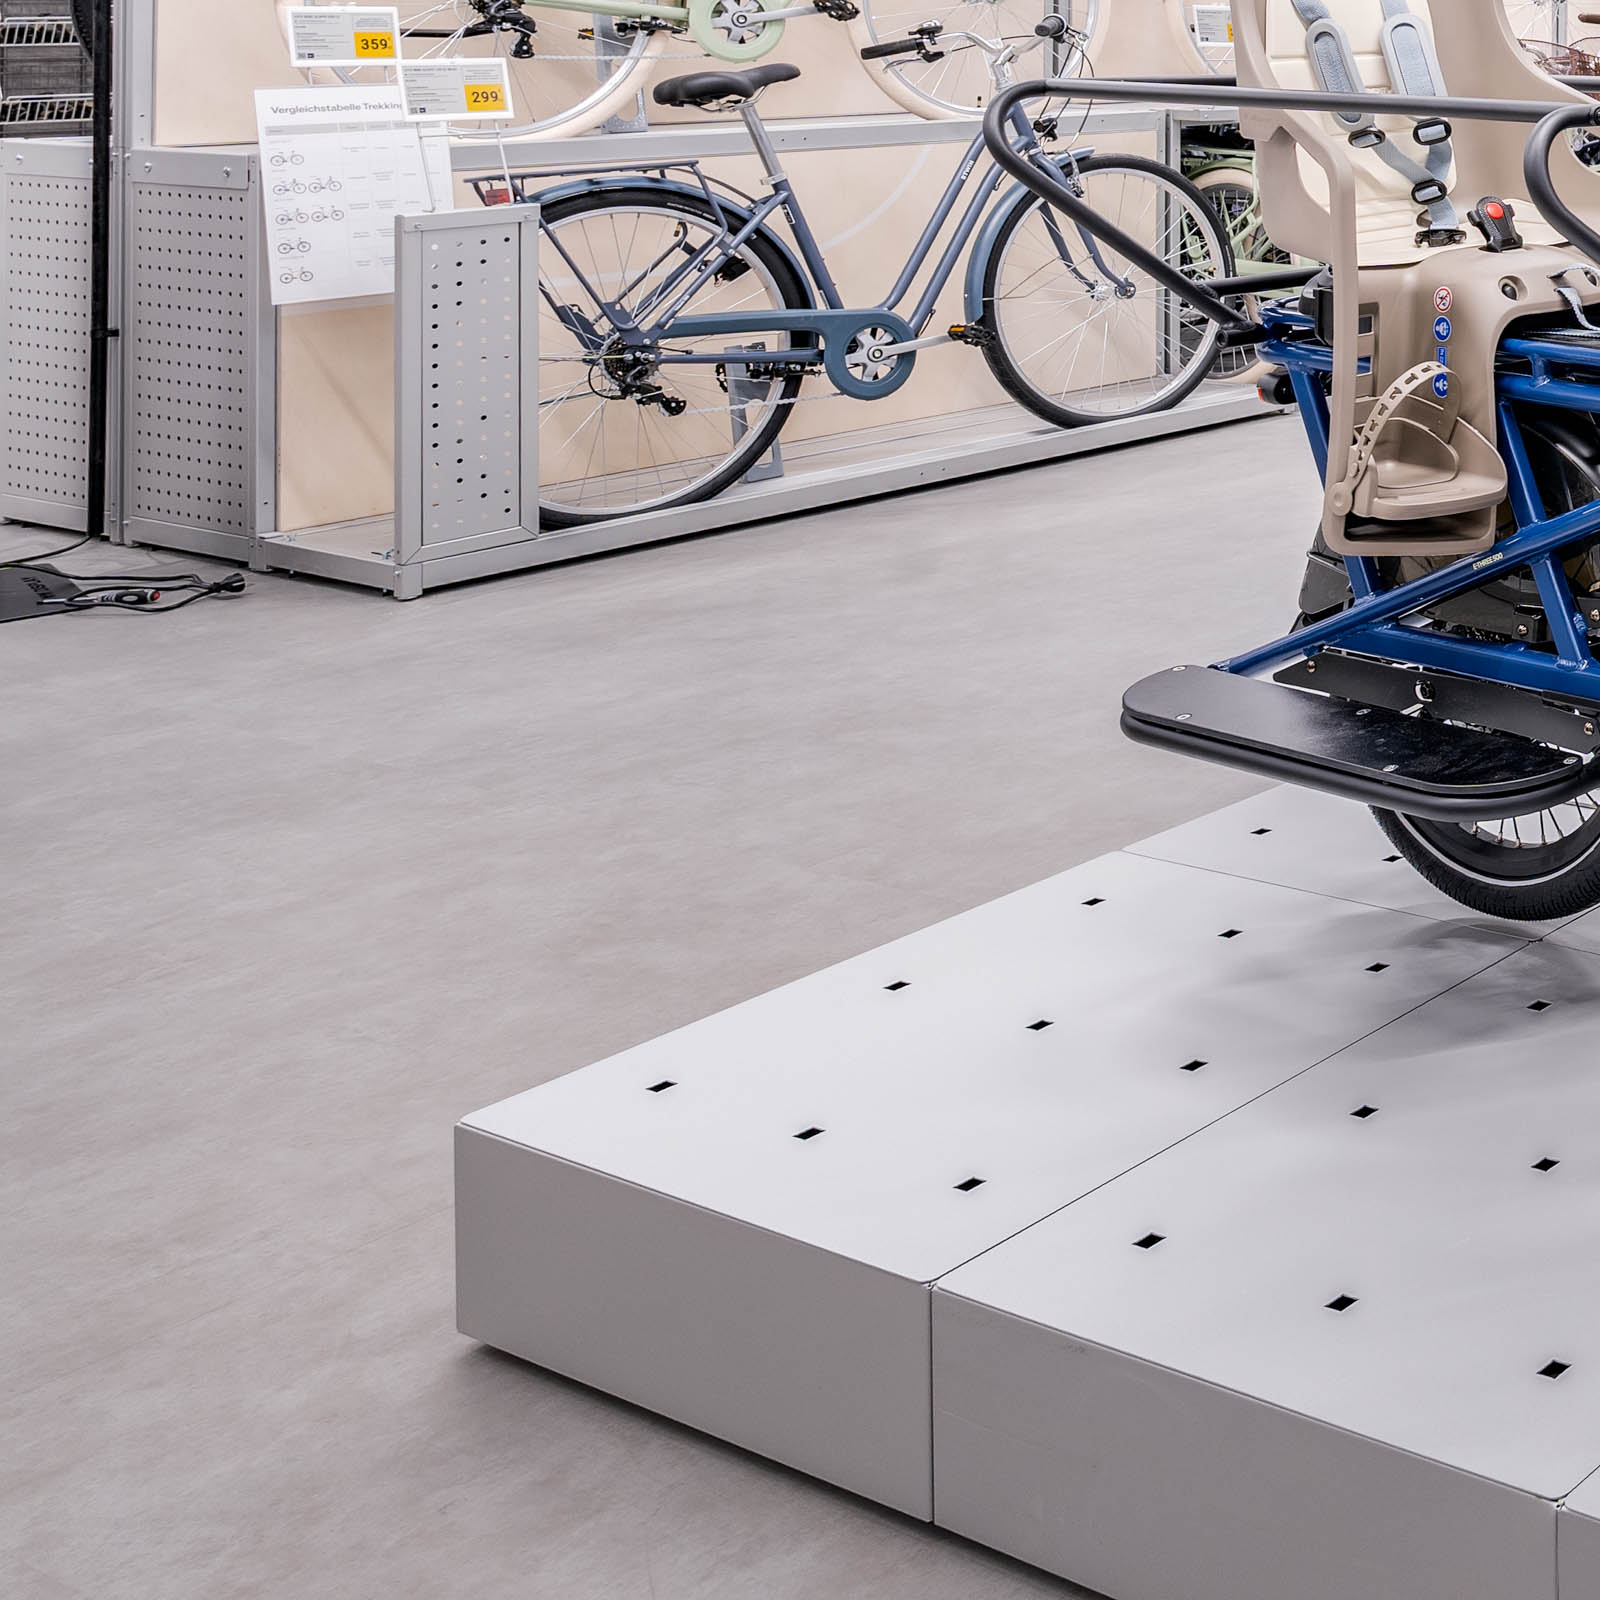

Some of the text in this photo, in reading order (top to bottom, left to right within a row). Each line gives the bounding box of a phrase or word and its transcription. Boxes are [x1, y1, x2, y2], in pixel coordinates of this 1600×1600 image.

[361, 39, 388, 50] 359
[472, 91, 498, 103] 299
[271, 103, 361, 115] Vergleichstabelle
